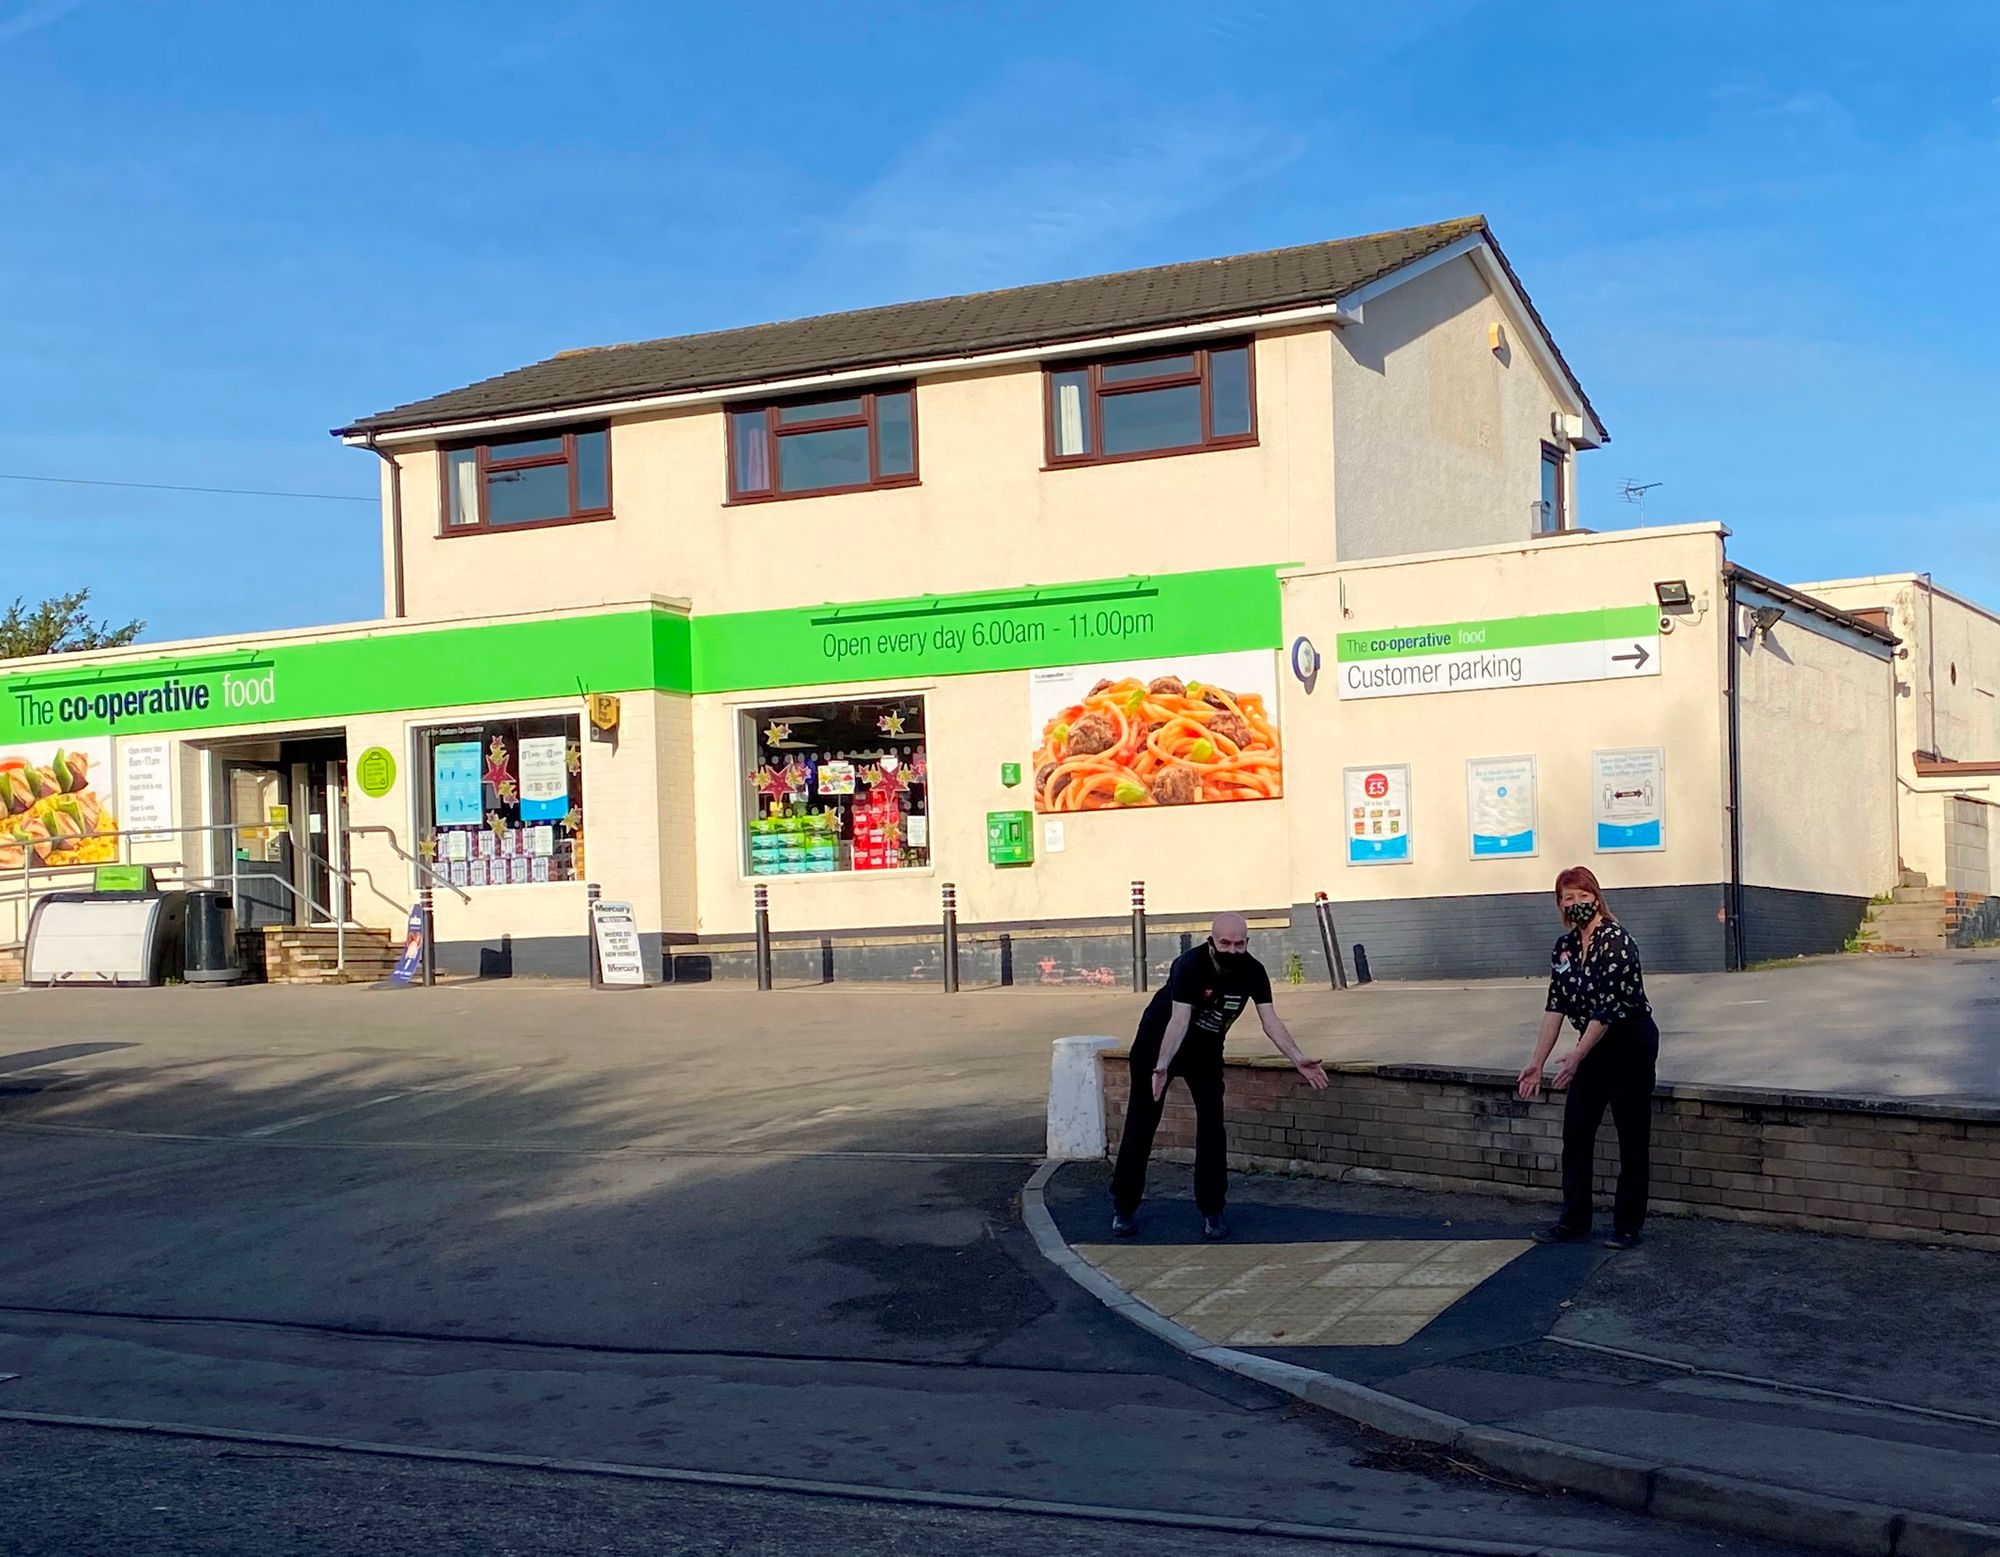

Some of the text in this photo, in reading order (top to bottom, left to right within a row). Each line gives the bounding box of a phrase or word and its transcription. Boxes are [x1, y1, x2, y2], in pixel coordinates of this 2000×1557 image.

[823, 633, 871, 661] Open
[878, 630, 928, 656] every
[933, 625, 966, 653] day
[973, 619, 1045, 646] 6.00am
[1069, 611, 1154, 639] 11.00pm
[1347, 627, 1486, 654] The co-operative food
[1348, 654, 1522, 689] Customer parking
[15, 669, 275, 727] The co-operative food
[1369, 782, 1385, 795] £5
[595, 904, 630, 914] Mercury
[607, 963, 639, 973] Mercury
